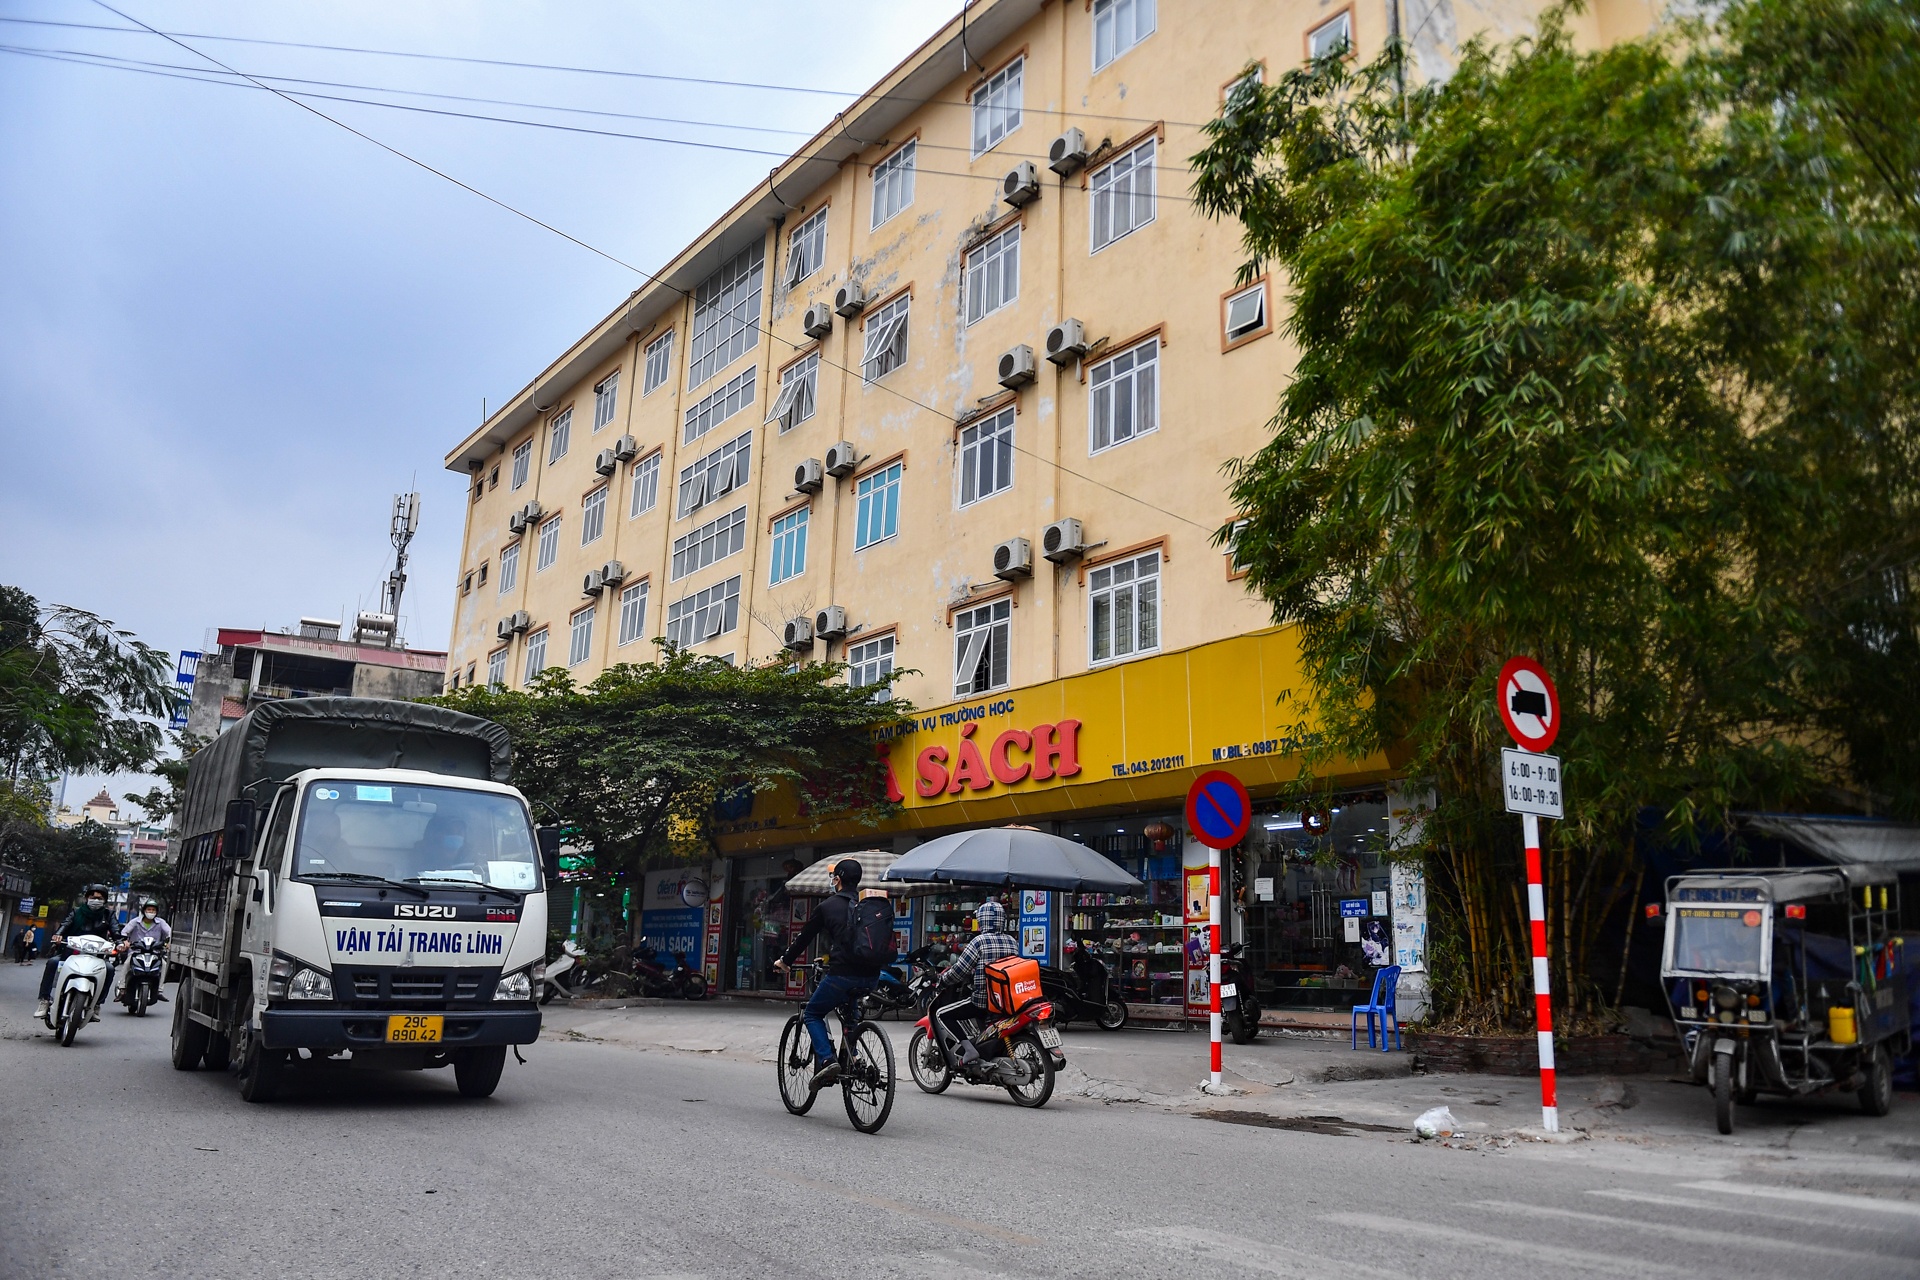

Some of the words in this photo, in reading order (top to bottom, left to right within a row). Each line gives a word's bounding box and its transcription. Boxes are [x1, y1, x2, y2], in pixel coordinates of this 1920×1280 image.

[896, 719, 919, 738] DỊCH
[922, 715, 937, 732] VỤ
[940, 705, 985, 727] TRƯỜNG
[989, 699, 1014, 717] HỌC
[1252, 739, 1278, 755] 0987
[915, 719, 1082, 798] SÁCH
[1112, 763, 1130, 777] TEL:
[1150, 755, 1184, 771] 2012111
[393, 904, 457, 919] ISUZU
[336, 926, 371, 955] VẬN
[376, 923, 403, 953] TẢI
[408, 931, 463, 954] TRANG
[668, 931, 695, 952] SÁCH
[403, 1016, 428, 1028] 29C
[392, 1029, 437, 1041] 890.42
